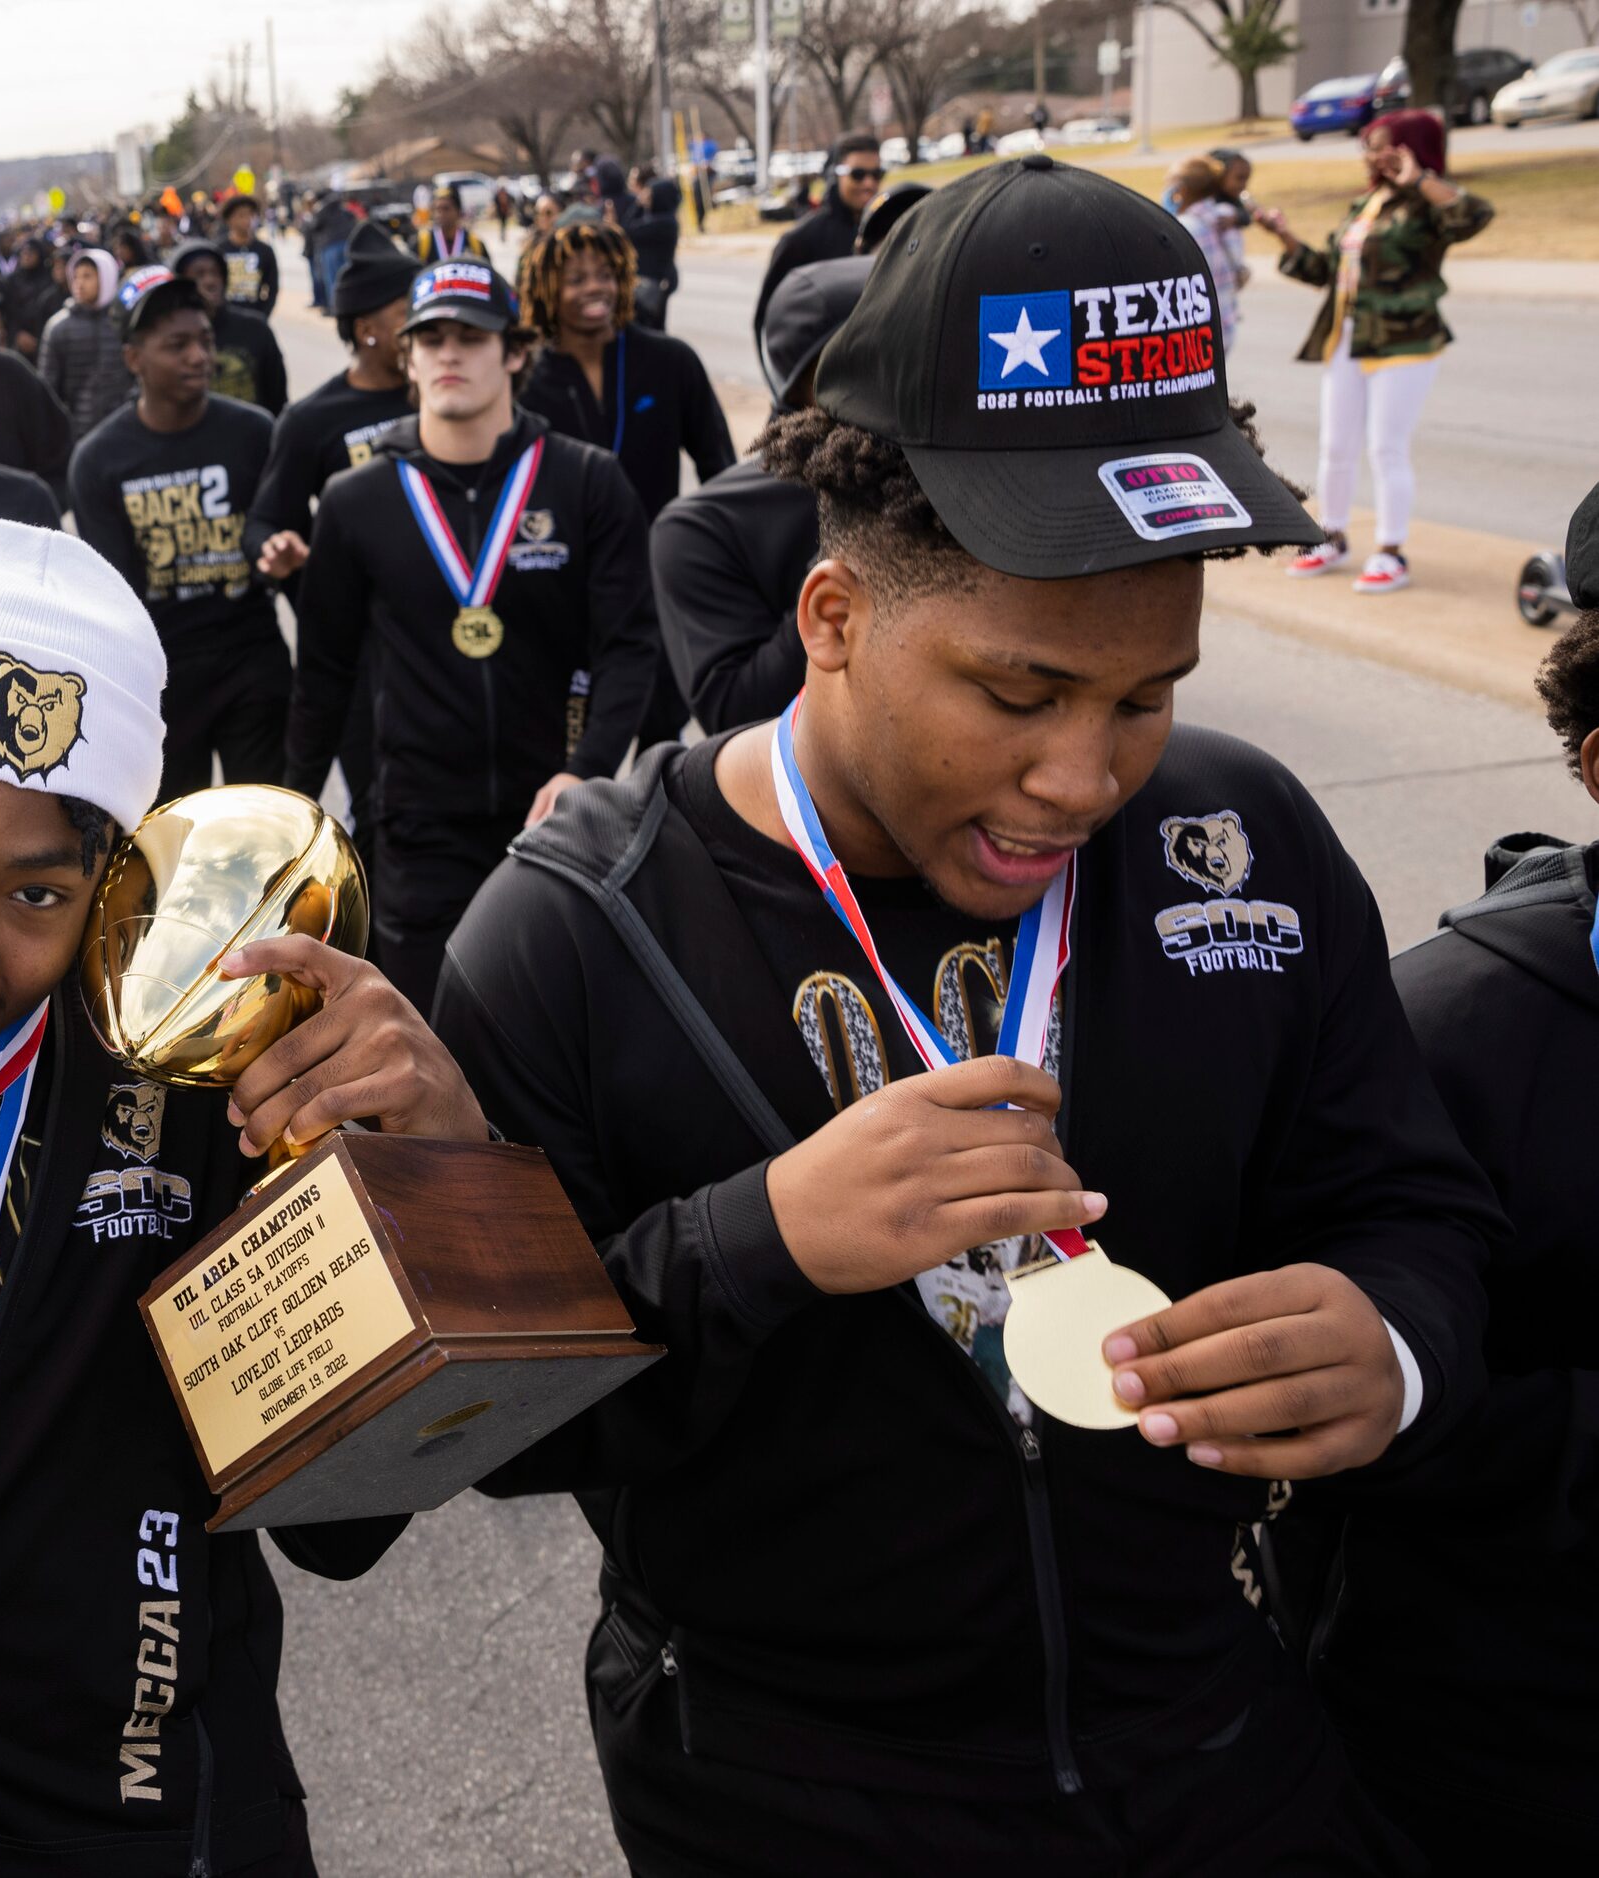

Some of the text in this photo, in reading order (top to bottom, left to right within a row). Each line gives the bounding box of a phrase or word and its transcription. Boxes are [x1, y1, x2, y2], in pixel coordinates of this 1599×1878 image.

[1075, 274, 1211, 339] TEXAS
[1077, 326, 1214, 386] STRONG
[977, 392, 1017, 410] 2022
[1024, 387, 1103, 408] FOOTBALL
[1110, 382, 1150, 400] STATE
[123, 464, 232, 529] BACK 2
[1125, 464, 1199, 488] OTTO
[175, 512, 246, 556] BACK
[1185, 948, 1285, 977] FOOTBALL
[173, 1184, 321, 1312] UIL AREA CHAMPIONS
[189, 1308, 210, 1331] UIL
[211, 1277, 246, 1314] CLASS
[247, 1264, 265, 1284] 5A
[265, 1222, 315, 1270] DIVISION
[183, 1237, 371, 1392] SOUTH OAK CLIFF GOLDEN BEARS
[218, 1253, 311, 1333] FOOTBALL PLAYOFFS
[230, 1300, 345, 1396] LOVEJOY LEOPARDS
[273, 1326, 286, 1340] VS
[258, 1338, 334, 1401] GLOBE LIFE FIELD
[260, 1353, 349, 1425] NOVEMBER 19, 2022
[119, 1509, 181, 1804] MECCA 23
